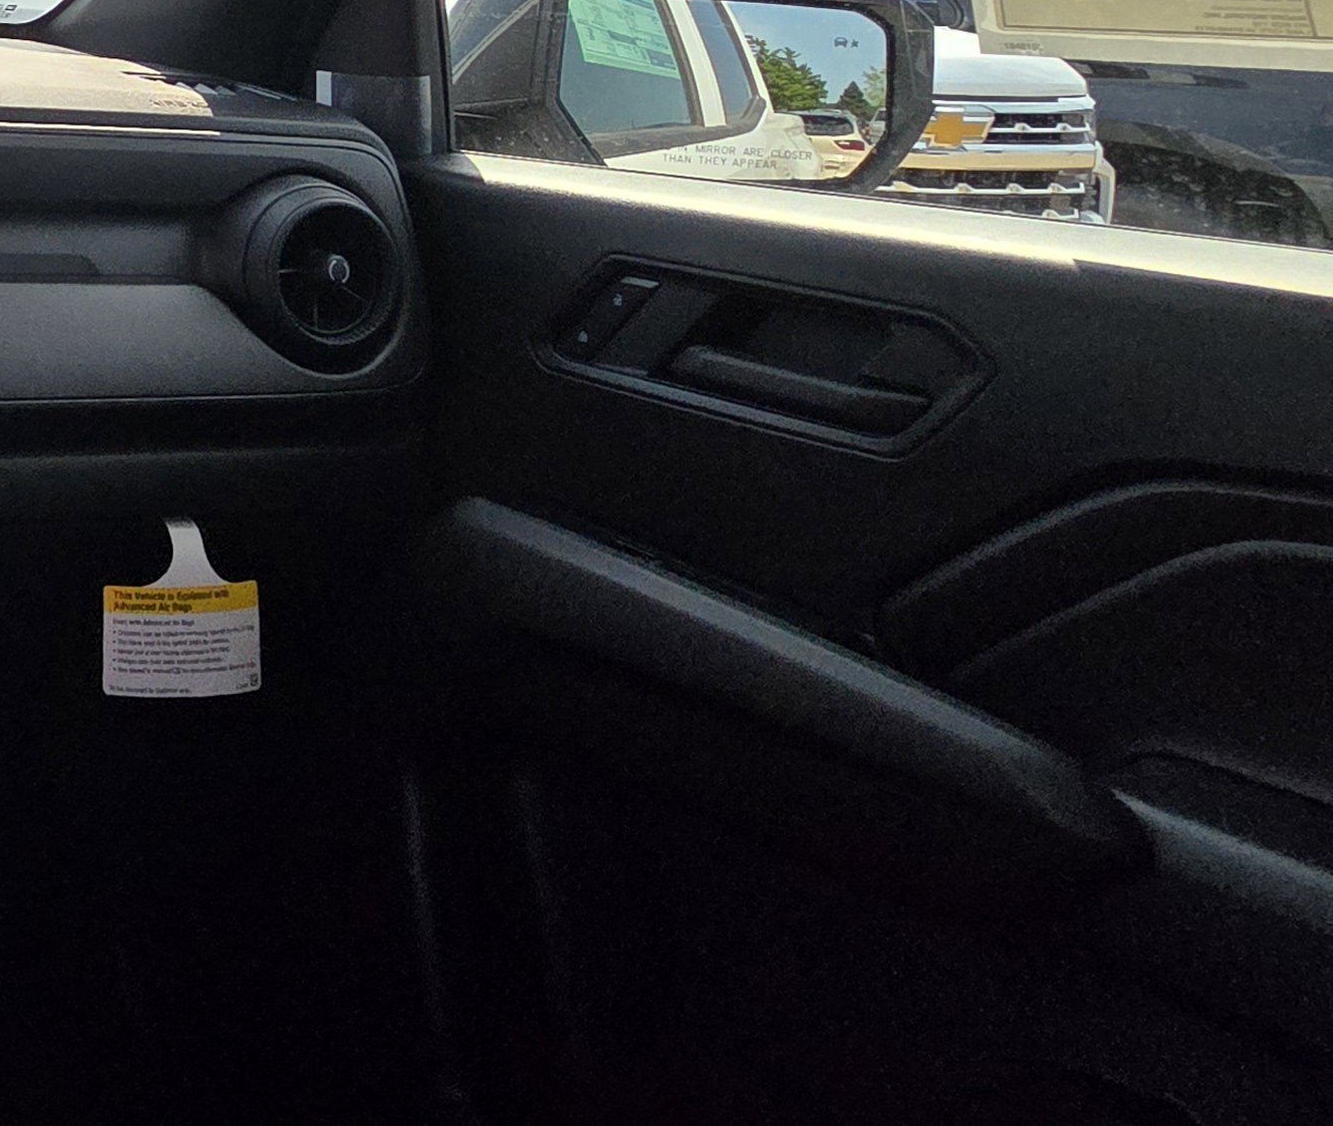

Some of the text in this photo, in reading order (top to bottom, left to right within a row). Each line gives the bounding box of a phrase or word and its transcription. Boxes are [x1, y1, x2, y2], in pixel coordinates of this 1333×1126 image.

[695, 145, 739, 155] MIRROR
[743, 147, 764, 158] ARE
[770, 149, 813, 160] CLOSER
[663, 153, 777, 169] THAN THEY APPEAR
